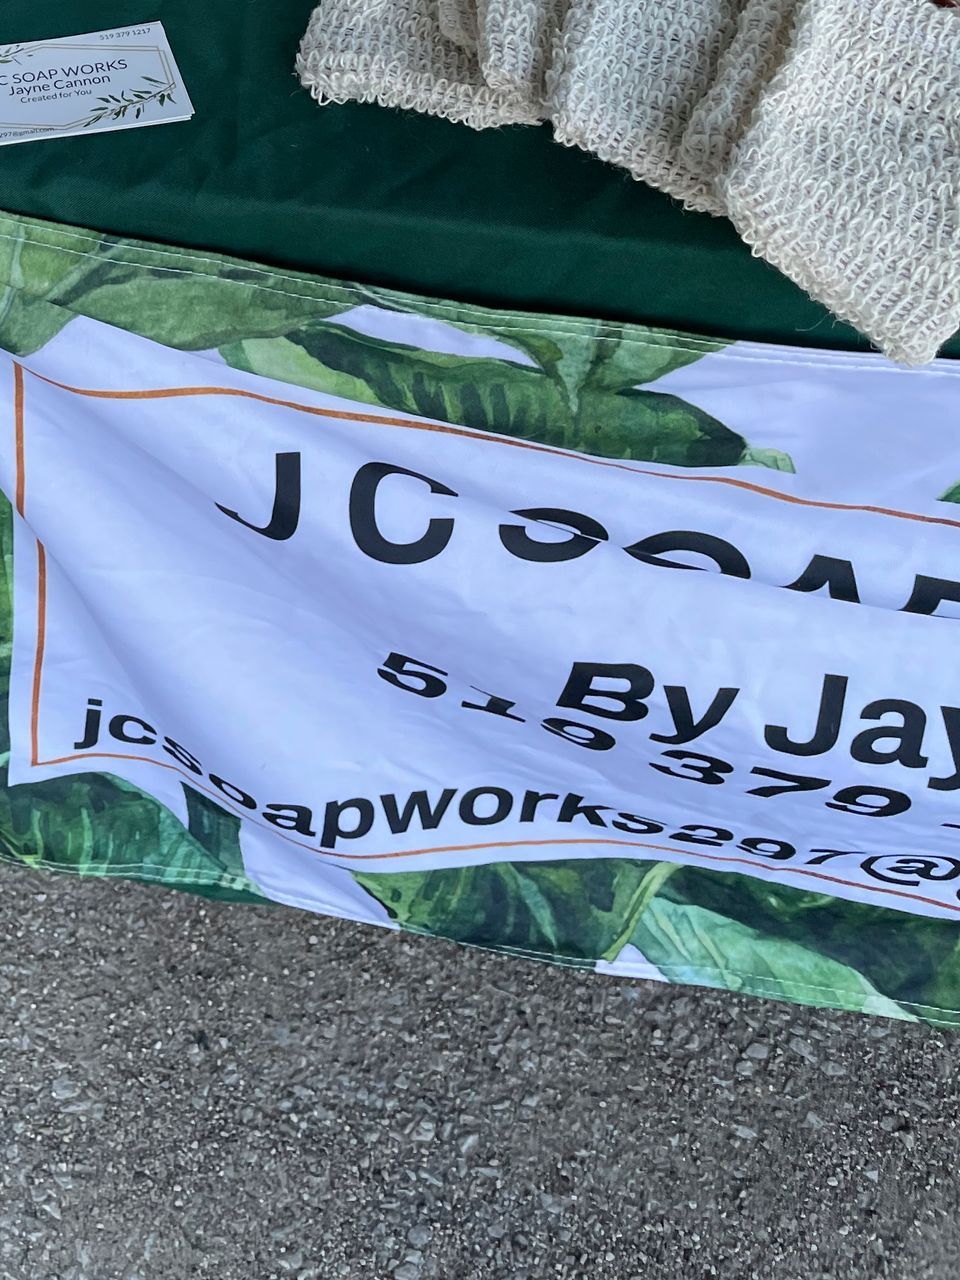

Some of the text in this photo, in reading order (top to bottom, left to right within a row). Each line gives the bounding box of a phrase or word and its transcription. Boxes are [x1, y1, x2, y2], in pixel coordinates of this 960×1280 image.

[100, 28, 151, 41] 519 379 1217
[13, 69, 58, 85] SOAP
[60, 59, 128, 78] WORKS
[9, 75, 110, 96] Jayne Cannon
[20, 93, 57, 104] Created
[74, 89, 92, 97] You
[554, 661, 740, 746] By
[378, 652, 913, 818] 519 379
[74, 698, 960, 902] jcsoapworks297@
